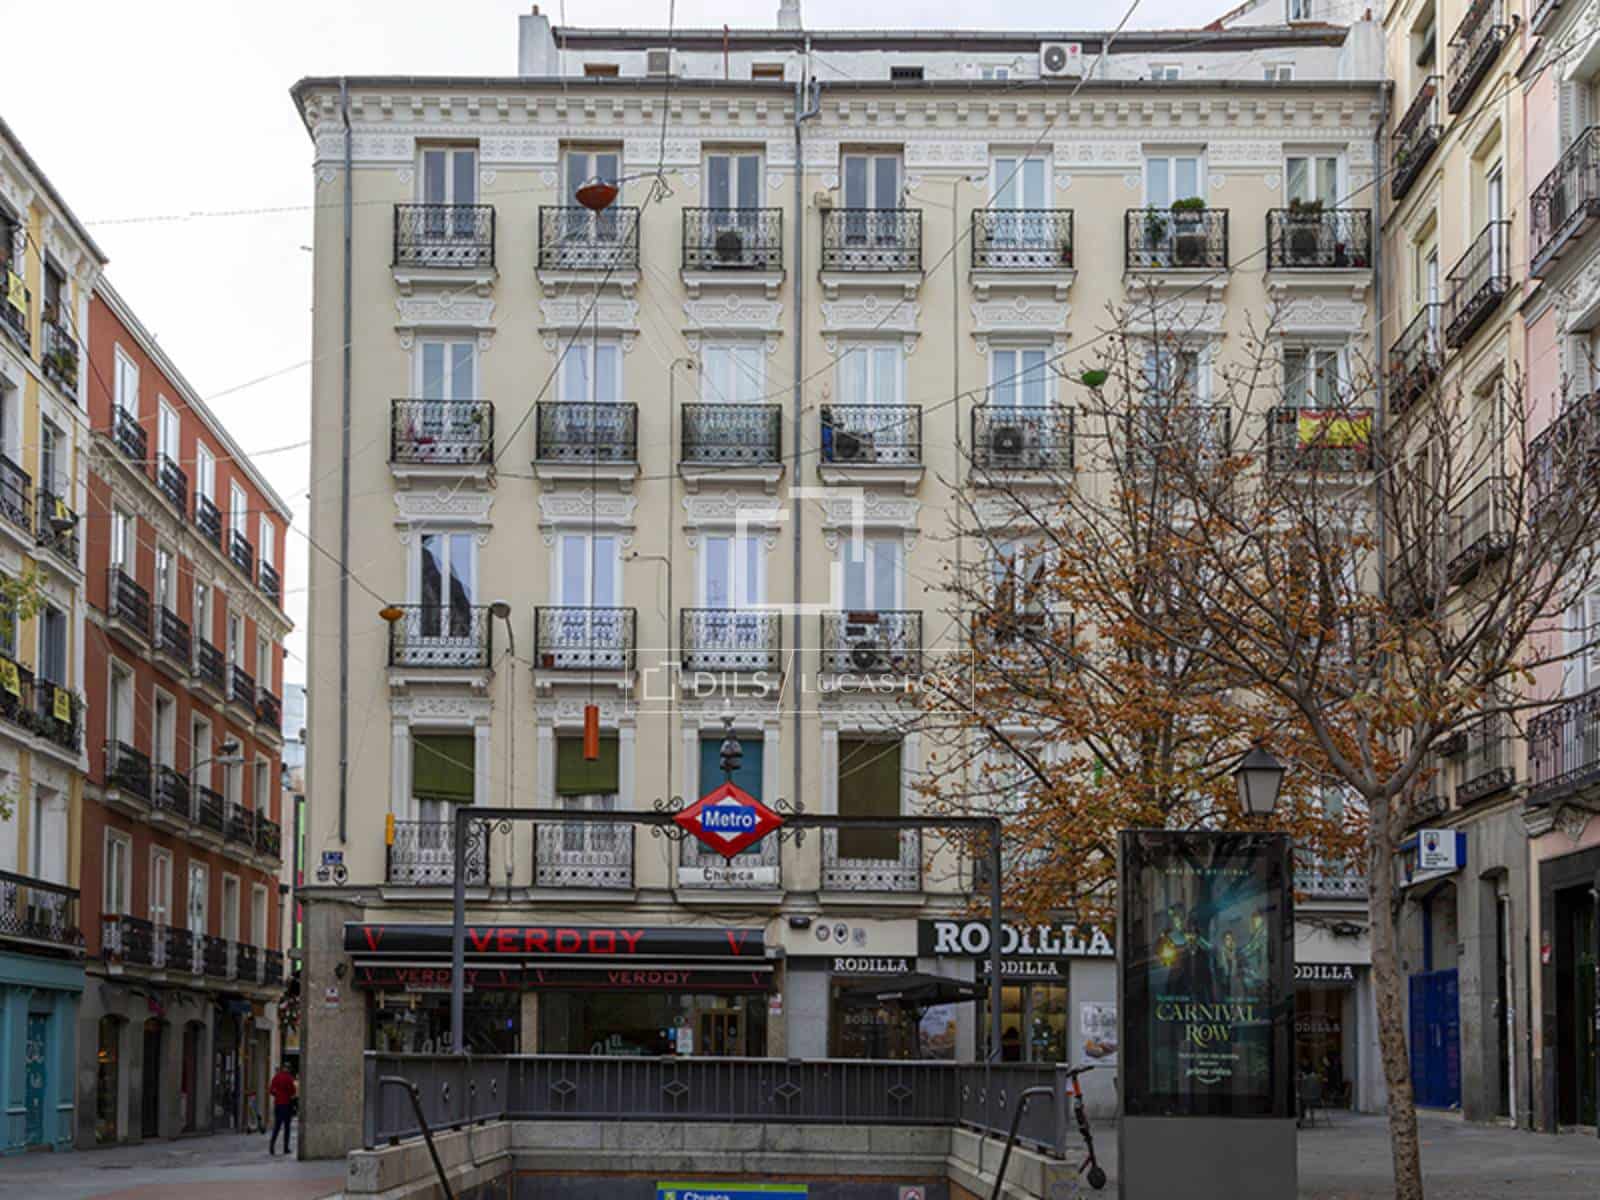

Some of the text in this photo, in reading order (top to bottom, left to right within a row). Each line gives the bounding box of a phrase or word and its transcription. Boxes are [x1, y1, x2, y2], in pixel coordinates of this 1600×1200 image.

[705, 810, 752, 828] Metro
[469, 927, 644, 954] VERDOY
[934, 922, 1115, 956] RODILLA
[834, 957, 909, 972] RODILLA
[1294, 965, 1354, 979] ODILLA
[396, 968, 480, 984] VERDY
[607, 970, 690, 985] VERDOY
[1155, 1003, 1259, 1021] CARNIVAL
[1184, 1023, 1232, 1048] ROW
